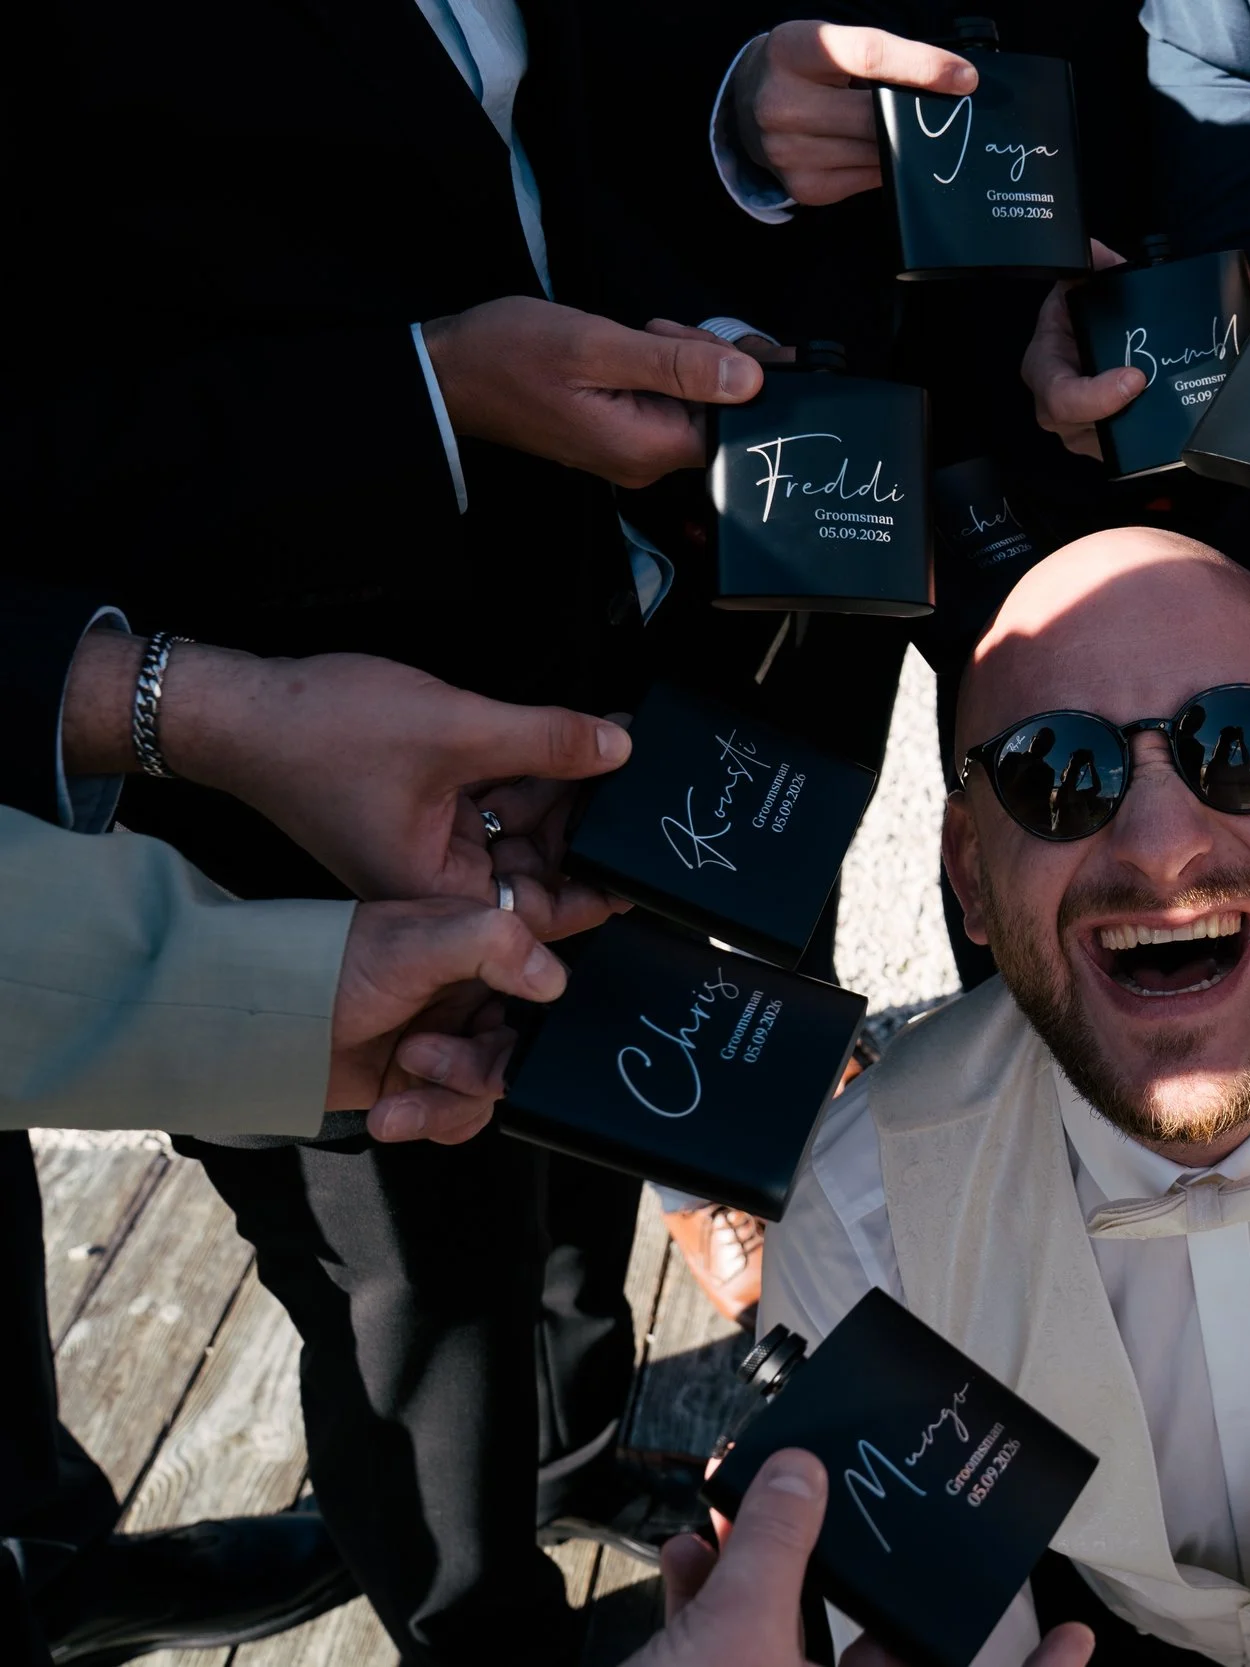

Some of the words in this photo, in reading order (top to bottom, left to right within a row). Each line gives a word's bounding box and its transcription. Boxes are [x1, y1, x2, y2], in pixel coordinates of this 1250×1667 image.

[916, 96, 1058, 184] Yaya
[987, 190, 1054, 203] Groomsman
[992, 206, 1053, 219] 05.09.2026
[746, 433, 905, 523] Freddi
[814, 508, 894, 525] Groomsman
[819, 526, 892, 543] 05.09.2026
[661, 729, 771, 872] Konsti
[752, 763, 790, 829] Groomsman
[771, 773, 806, 833] 05.09.2026
[617, 966, 740, 1118] Chris
[720, 990, 764, 1060] Groomsman
[743, 999, 783, 1064] 05.09.2026
[844, 1382, 970, 1553] Mungo
[945, 1422, 1006, 1496] Groomsman
[967, 1437, 1022, 1508] 05.09.2026
